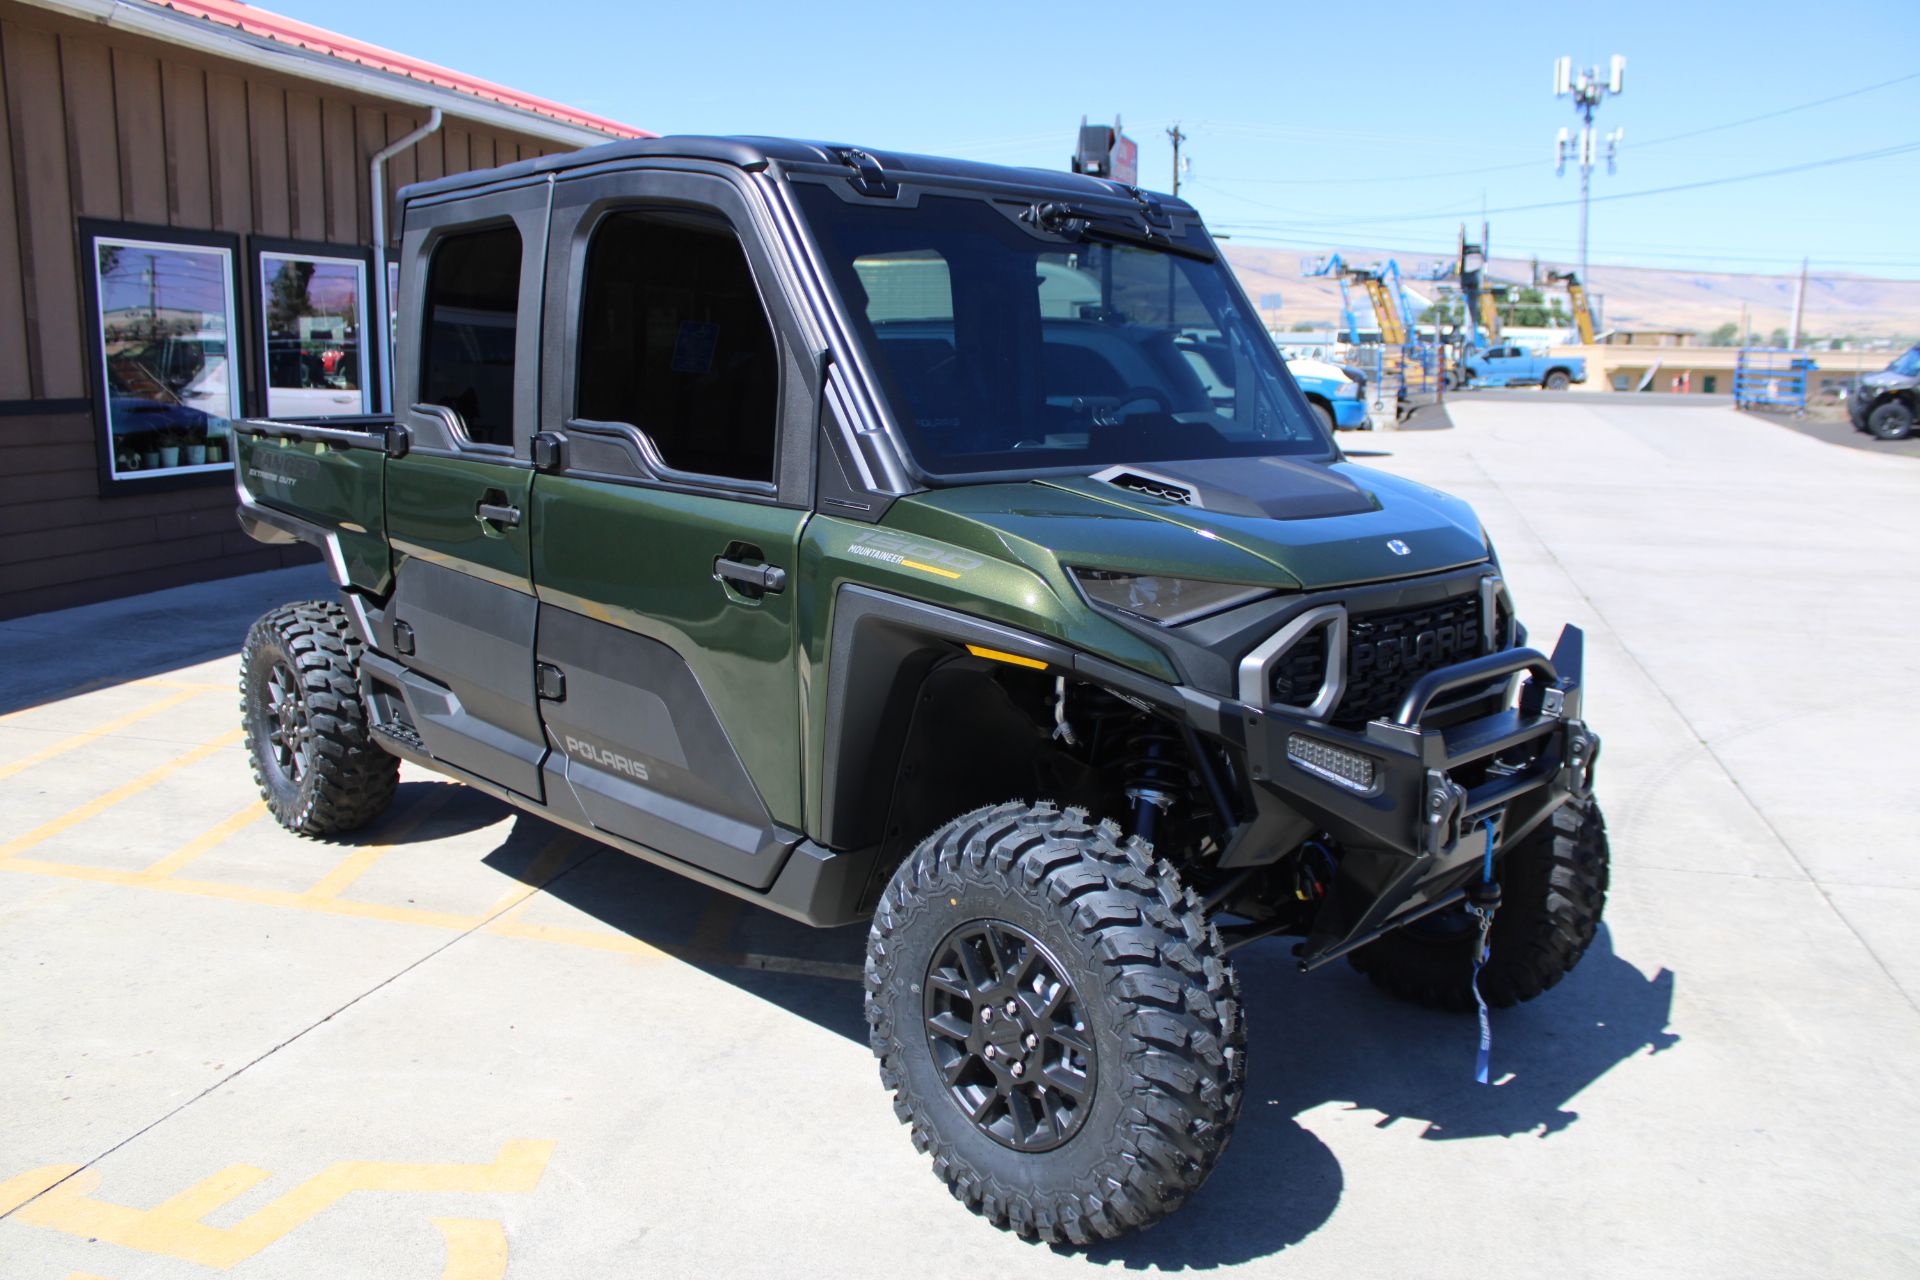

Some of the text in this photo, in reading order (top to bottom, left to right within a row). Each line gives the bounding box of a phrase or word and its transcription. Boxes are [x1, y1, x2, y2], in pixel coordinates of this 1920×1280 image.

[249, 468, 298, 486] EXTREME DUTY
[252, 451, 320, 480] RANGER
[848, 544, 904, 565] MOUNTAINEER
[855, 532, 985, 570] 1500
[1352, 620, 1478, 677] POLARIS
[565, 735, 649, 781] POLARIS
